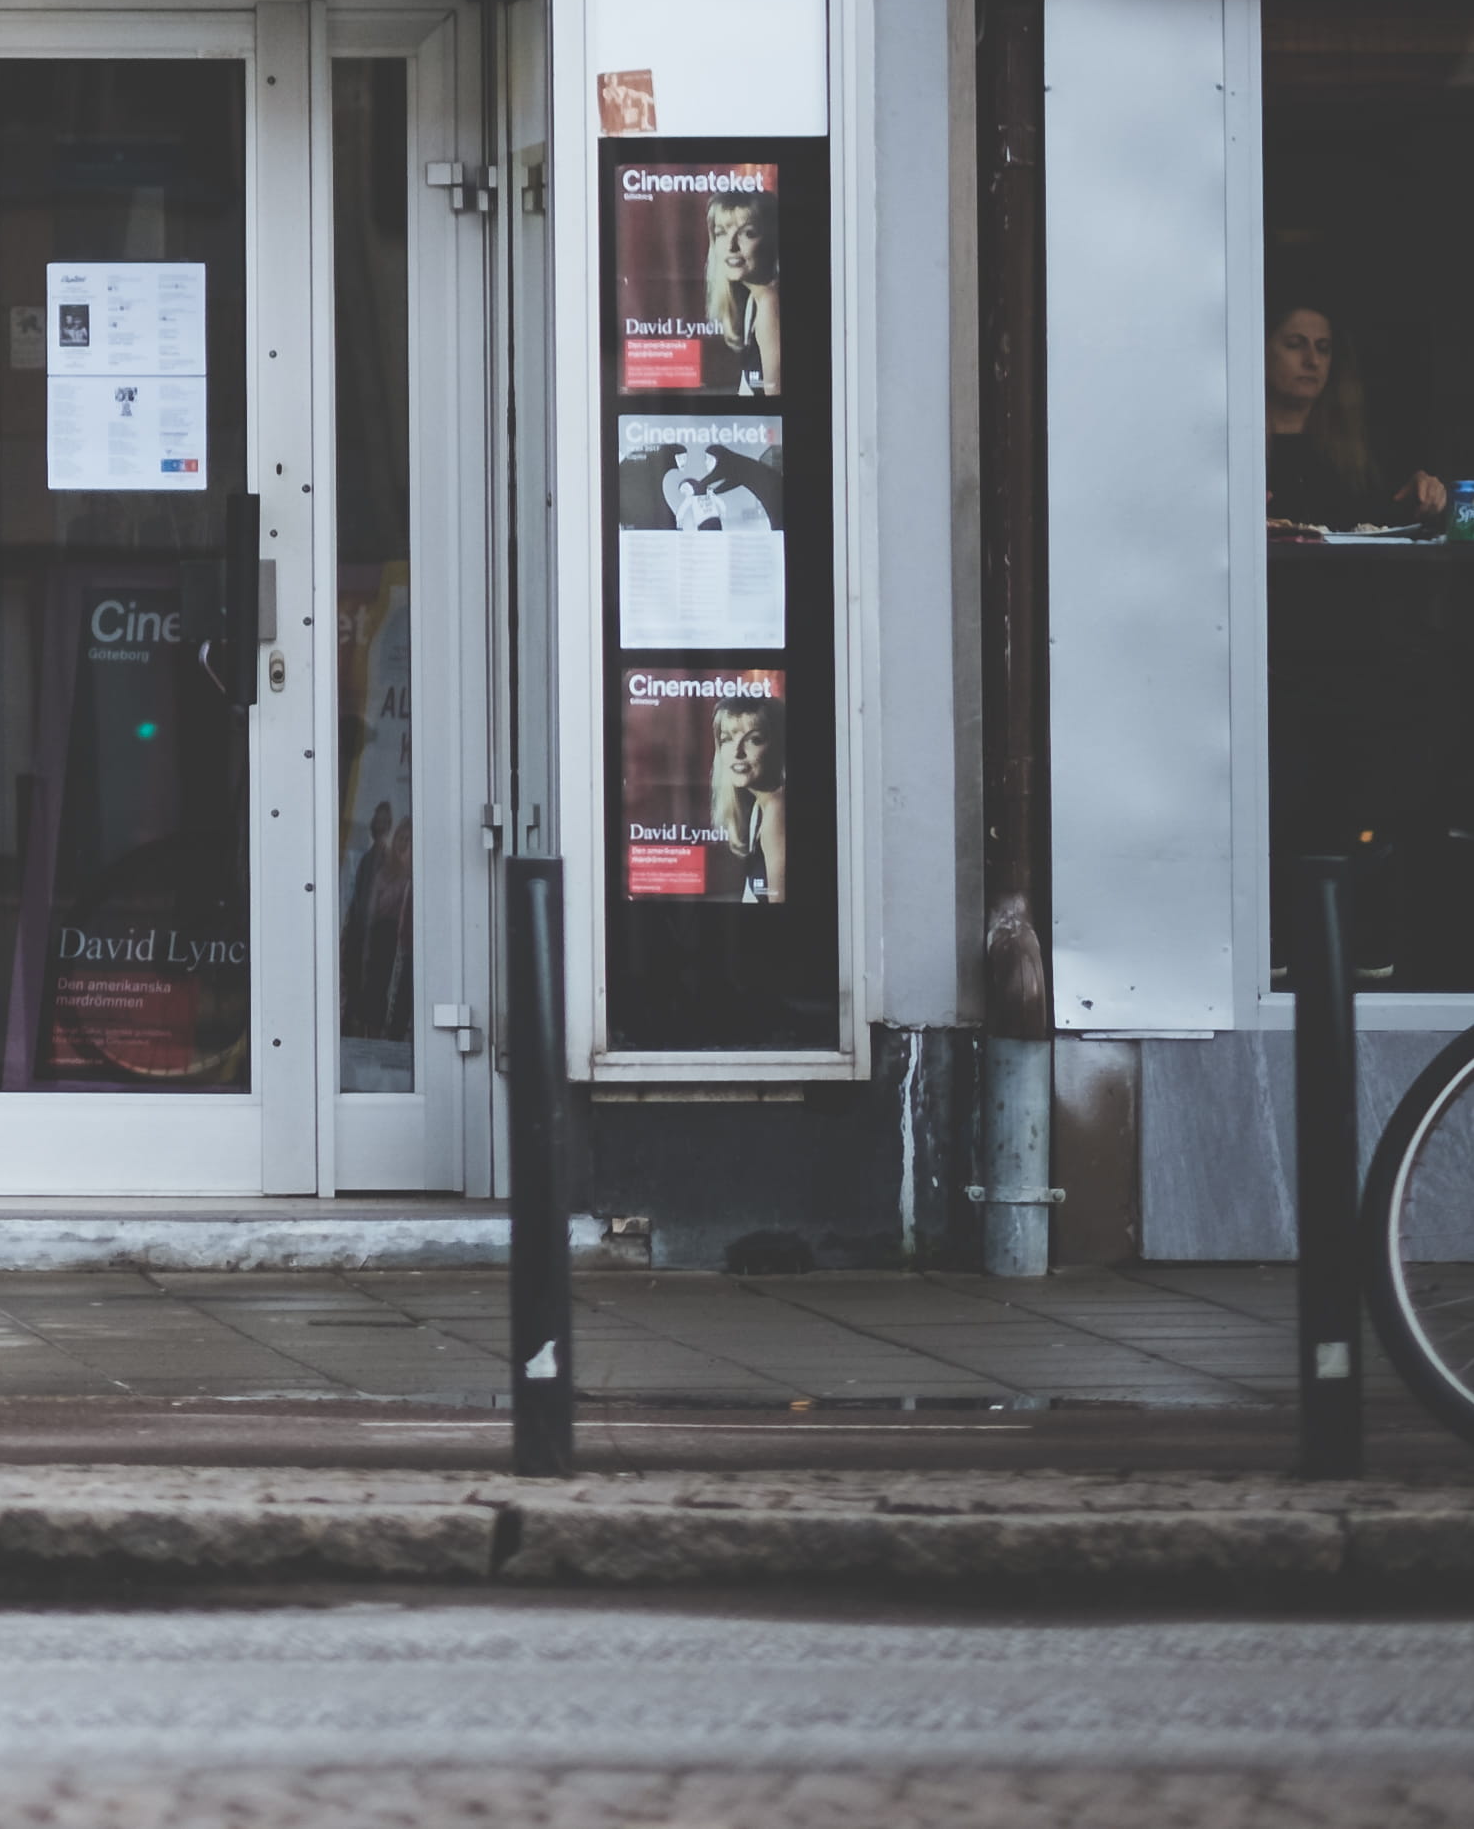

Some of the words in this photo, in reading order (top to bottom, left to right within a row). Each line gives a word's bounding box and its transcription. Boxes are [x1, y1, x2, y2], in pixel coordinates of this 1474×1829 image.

[623, 169, 764, 193] Cinemateket
[625, 318, 672, 335] David
[676, 318, 724, 338] Lynch
[625, 422, 767, 443] Cinemateket
[88, 647, 149, 664] Göteborg
[628, 674, 772, 698] Cinemateket
[629, 823, 677, 841] David
[680, 823, 729, 844] Lynch
[59, 926, 156, 962] David
[57, 977, 84, 990] Den
[87, 978, 172, 994] amerikanska
[56, 993, 144, 1009] mardrömmen
